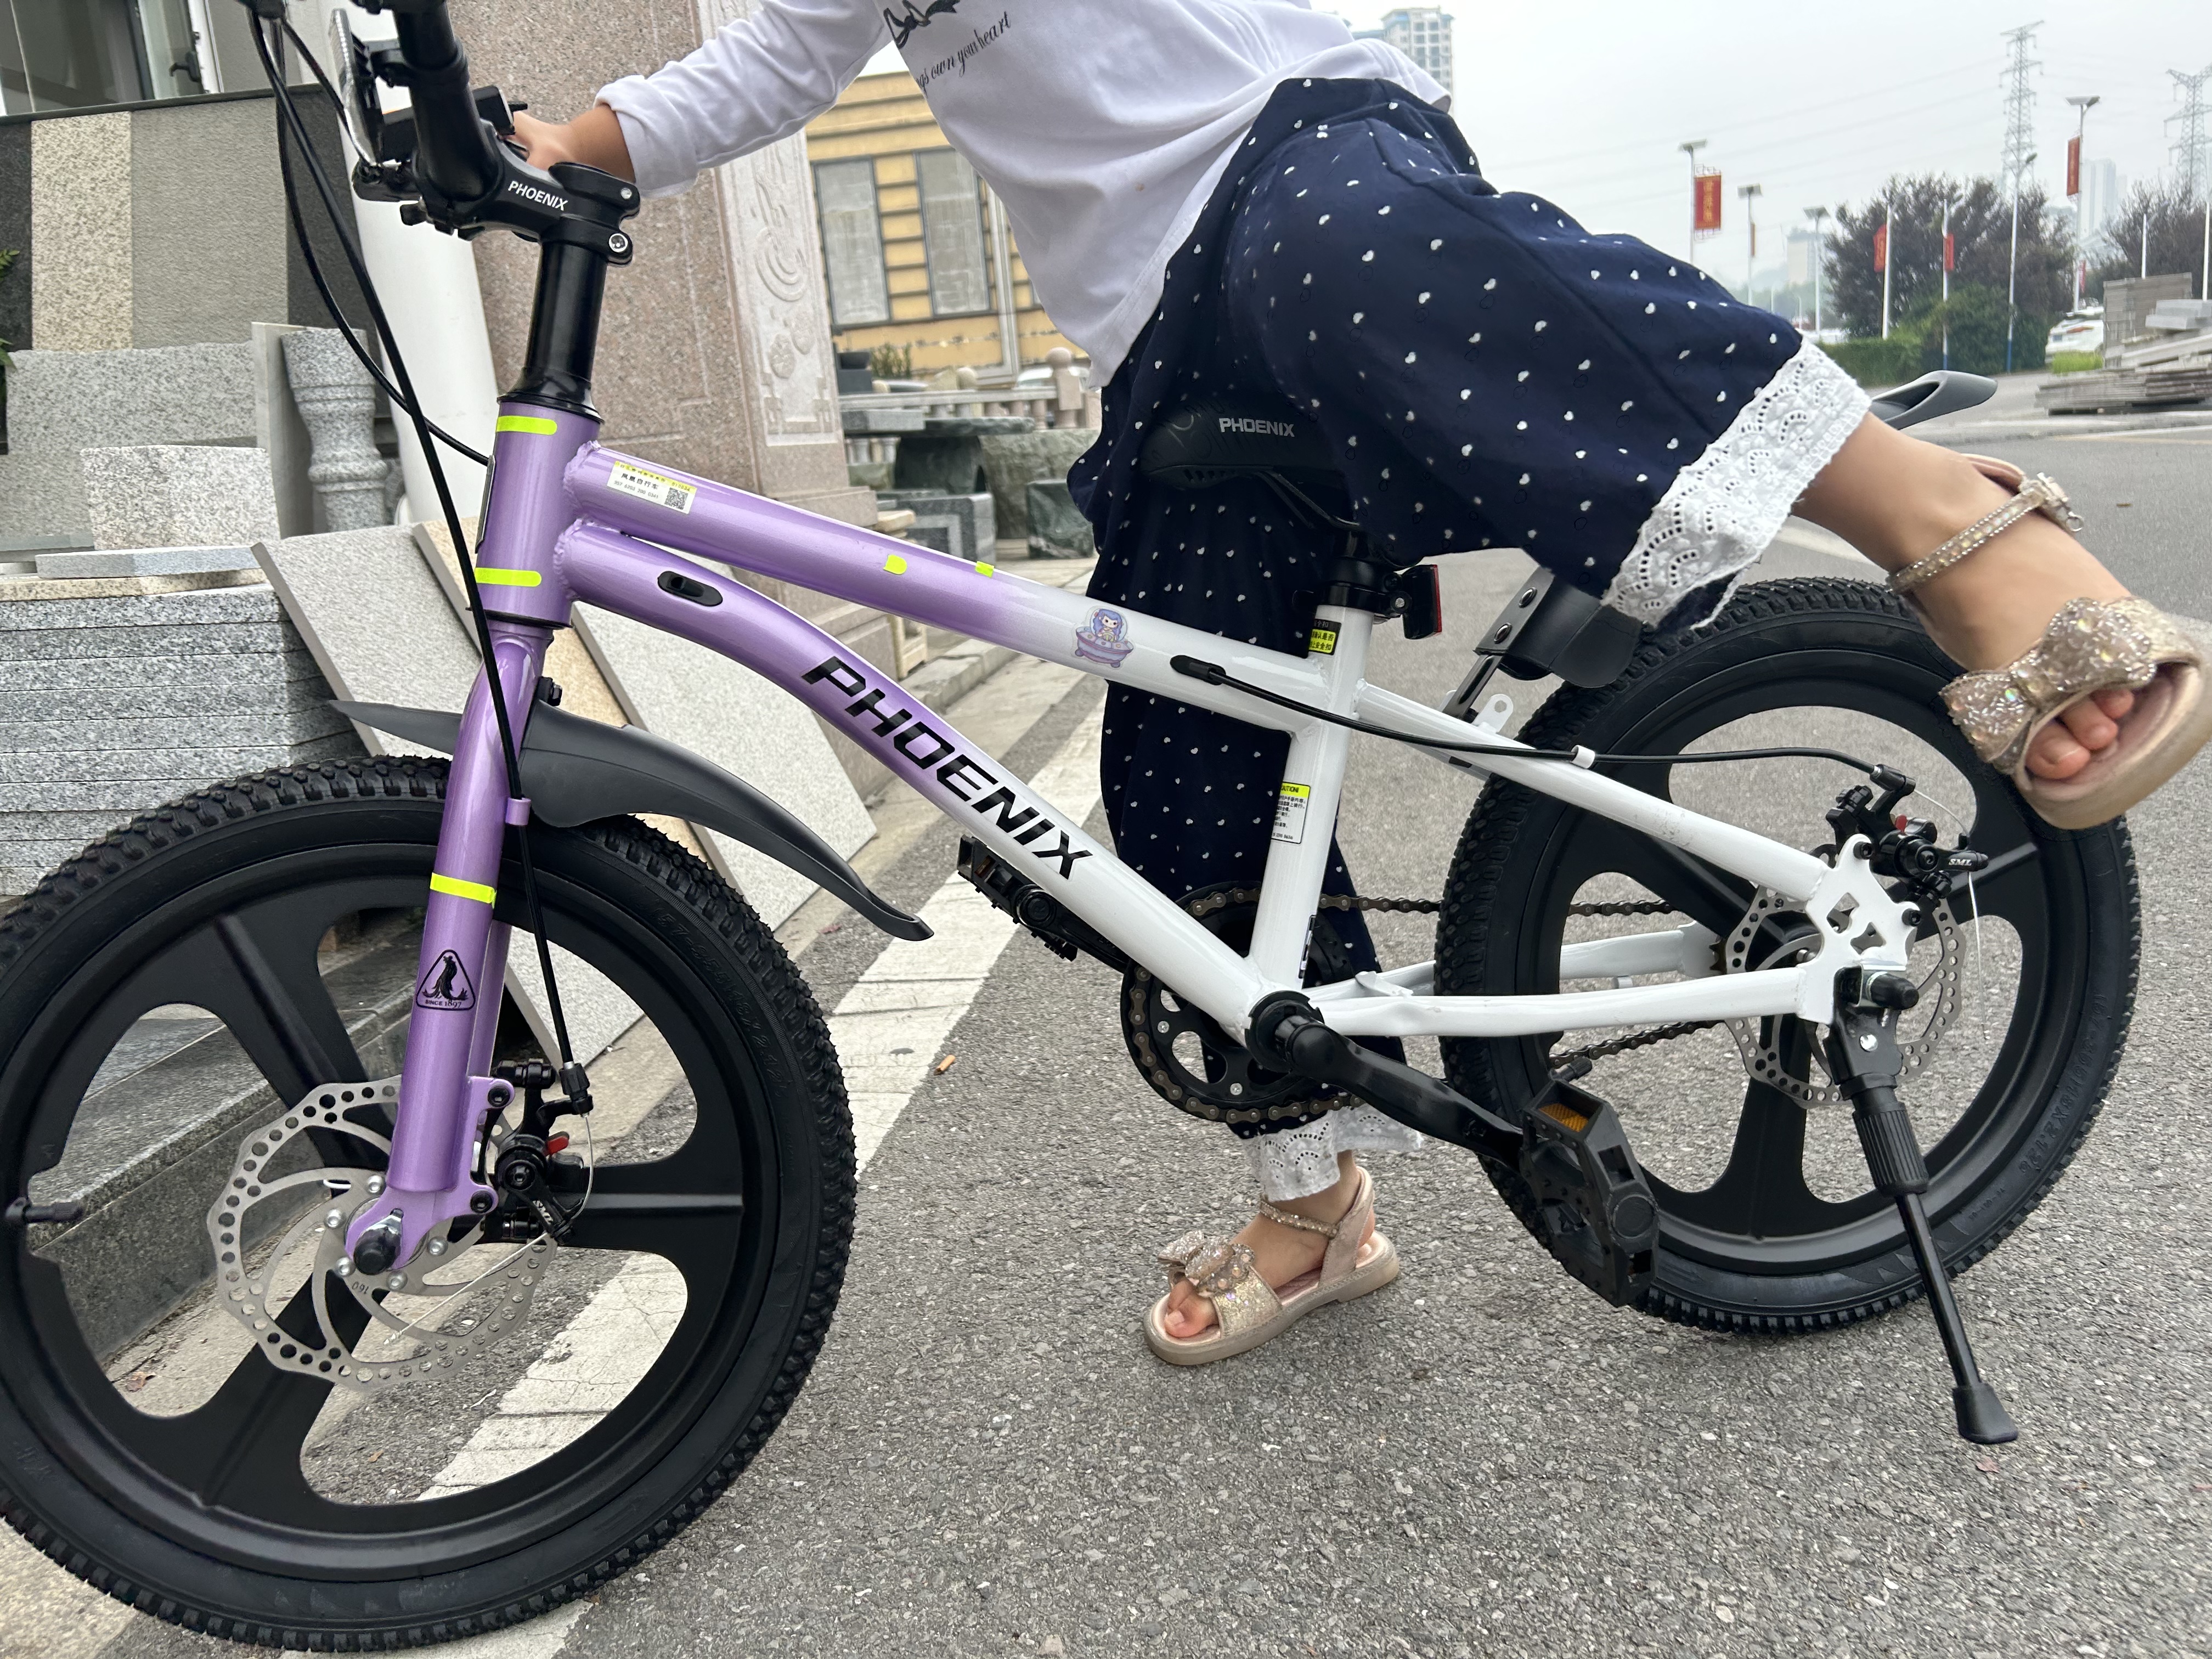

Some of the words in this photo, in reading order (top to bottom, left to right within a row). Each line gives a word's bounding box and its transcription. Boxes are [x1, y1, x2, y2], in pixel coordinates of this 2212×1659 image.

[931, 55, 955, 80] own
[974, 11, 1012, 49] heart
[507, 180, 568, 211] PHOENIX
[1218, 417, 1295, 438] PHOENIX
[800, 656, 1093, 879] PHOENIX
[445, 1000, 461, 1009] 1897
[532, 1200, 553, 1224] SML
[352, 1281, 369, 1295] 160
